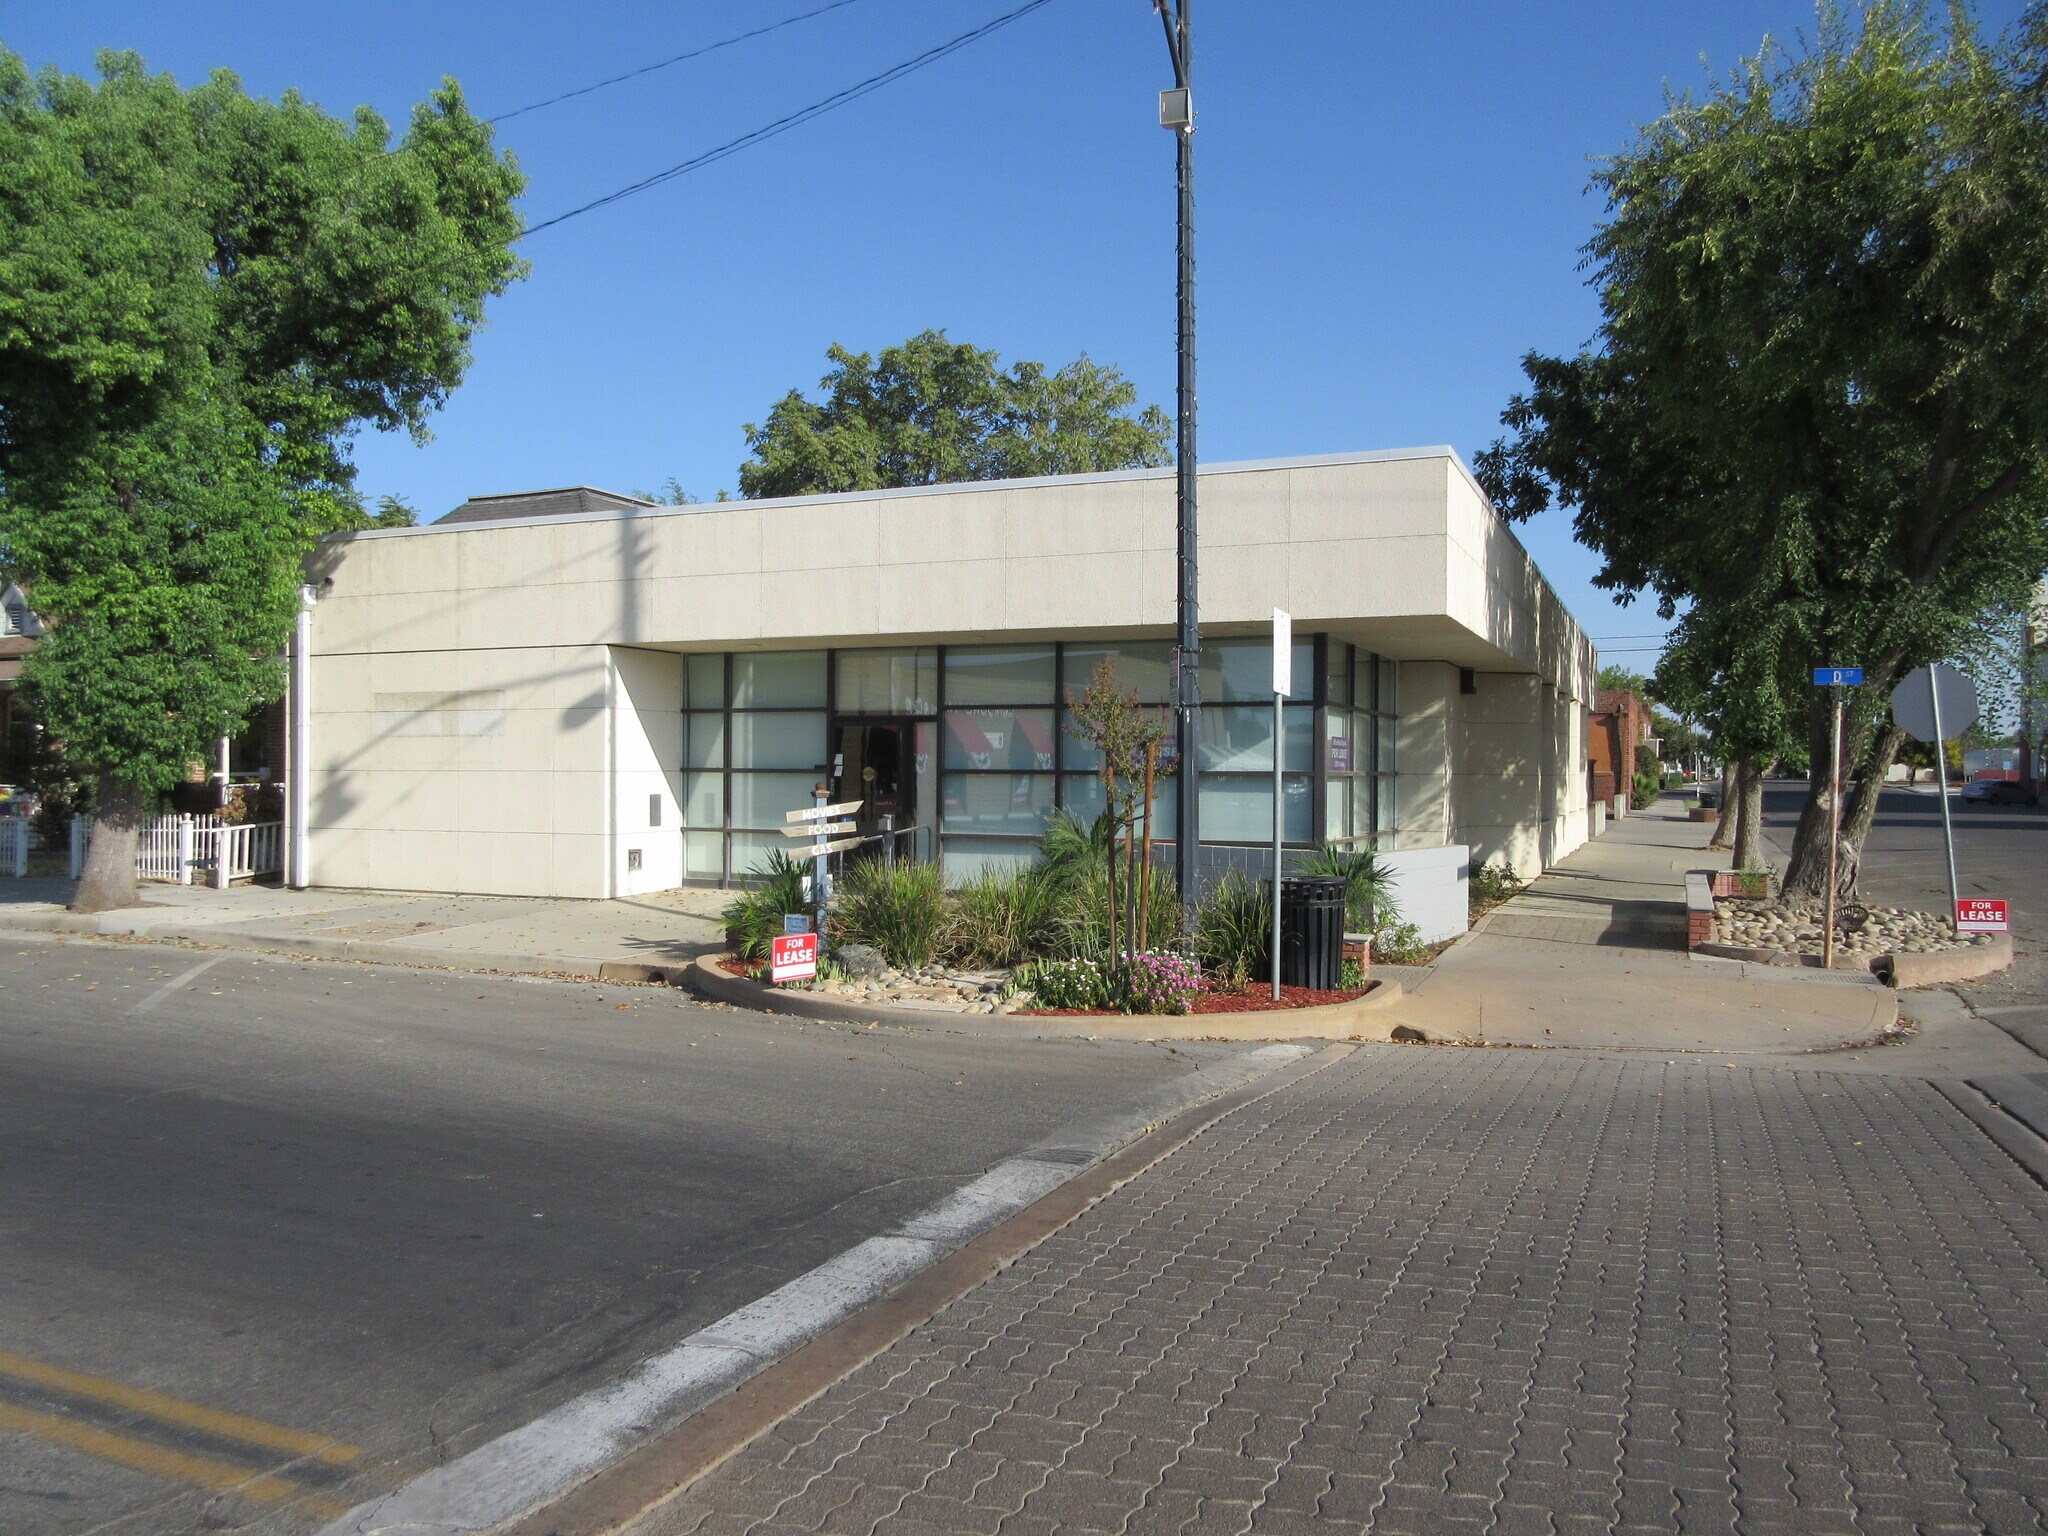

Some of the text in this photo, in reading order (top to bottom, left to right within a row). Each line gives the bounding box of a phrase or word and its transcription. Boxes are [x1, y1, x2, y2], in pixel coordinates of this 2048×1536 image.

[1833, 670, 1842, 682] D
[802, 805, 841, 820] MOVIES
[808, 823, 839, 835] FOOD
[811, 843, 833, 855] GAS
[1971, 901, 1992, 910] FOR
[1960, 910, 2003, 921] LEASE
[786, 938, 804, 949] FOR
[776, 948, 813, 966] LEASE
